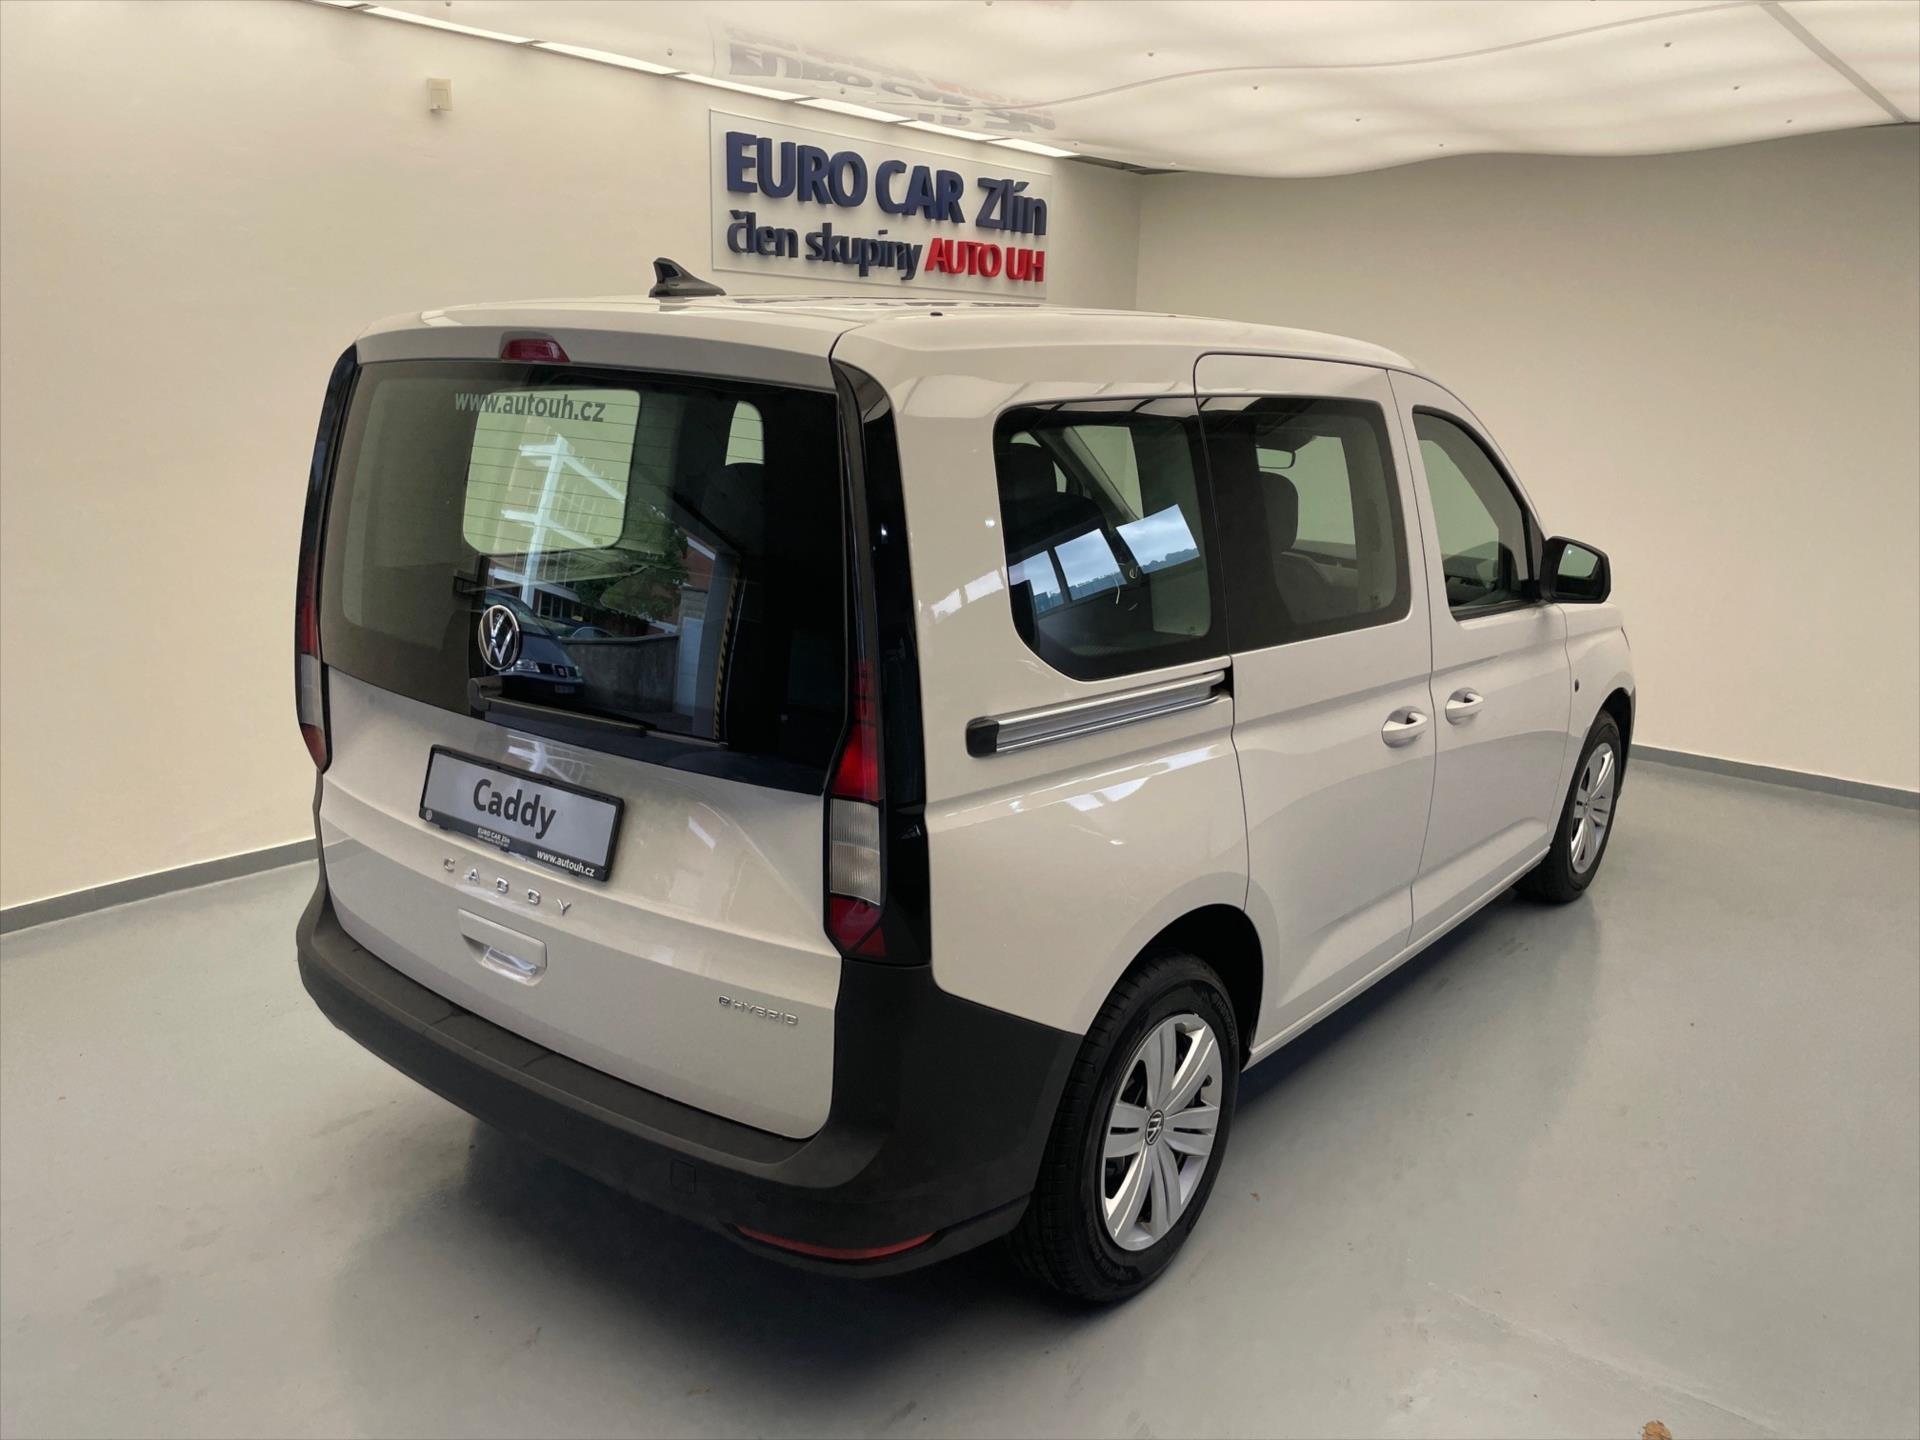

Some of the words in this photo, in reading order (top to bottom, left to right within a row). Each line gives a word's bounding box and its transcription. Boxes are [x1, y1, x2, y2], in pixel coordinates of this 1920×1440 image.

[726, 131, 868, 207] EURO
[875, 160, 965, 223] CAR
[975, 177, 1047, 235] Zlín
[727, 209, 798, 258] člen
[805, 222, 923, 280] skupiny
[924, 238, 1002, 277] AUTO
[1005, 247, 1045, 282] UH
[455, 393, 606, 422] www.autouh.cz
[473, 779, 556, 839] Caddy
[443, 857, 572, 915] CADDY
[536, 850, 595, 877] www.autouh.cz
